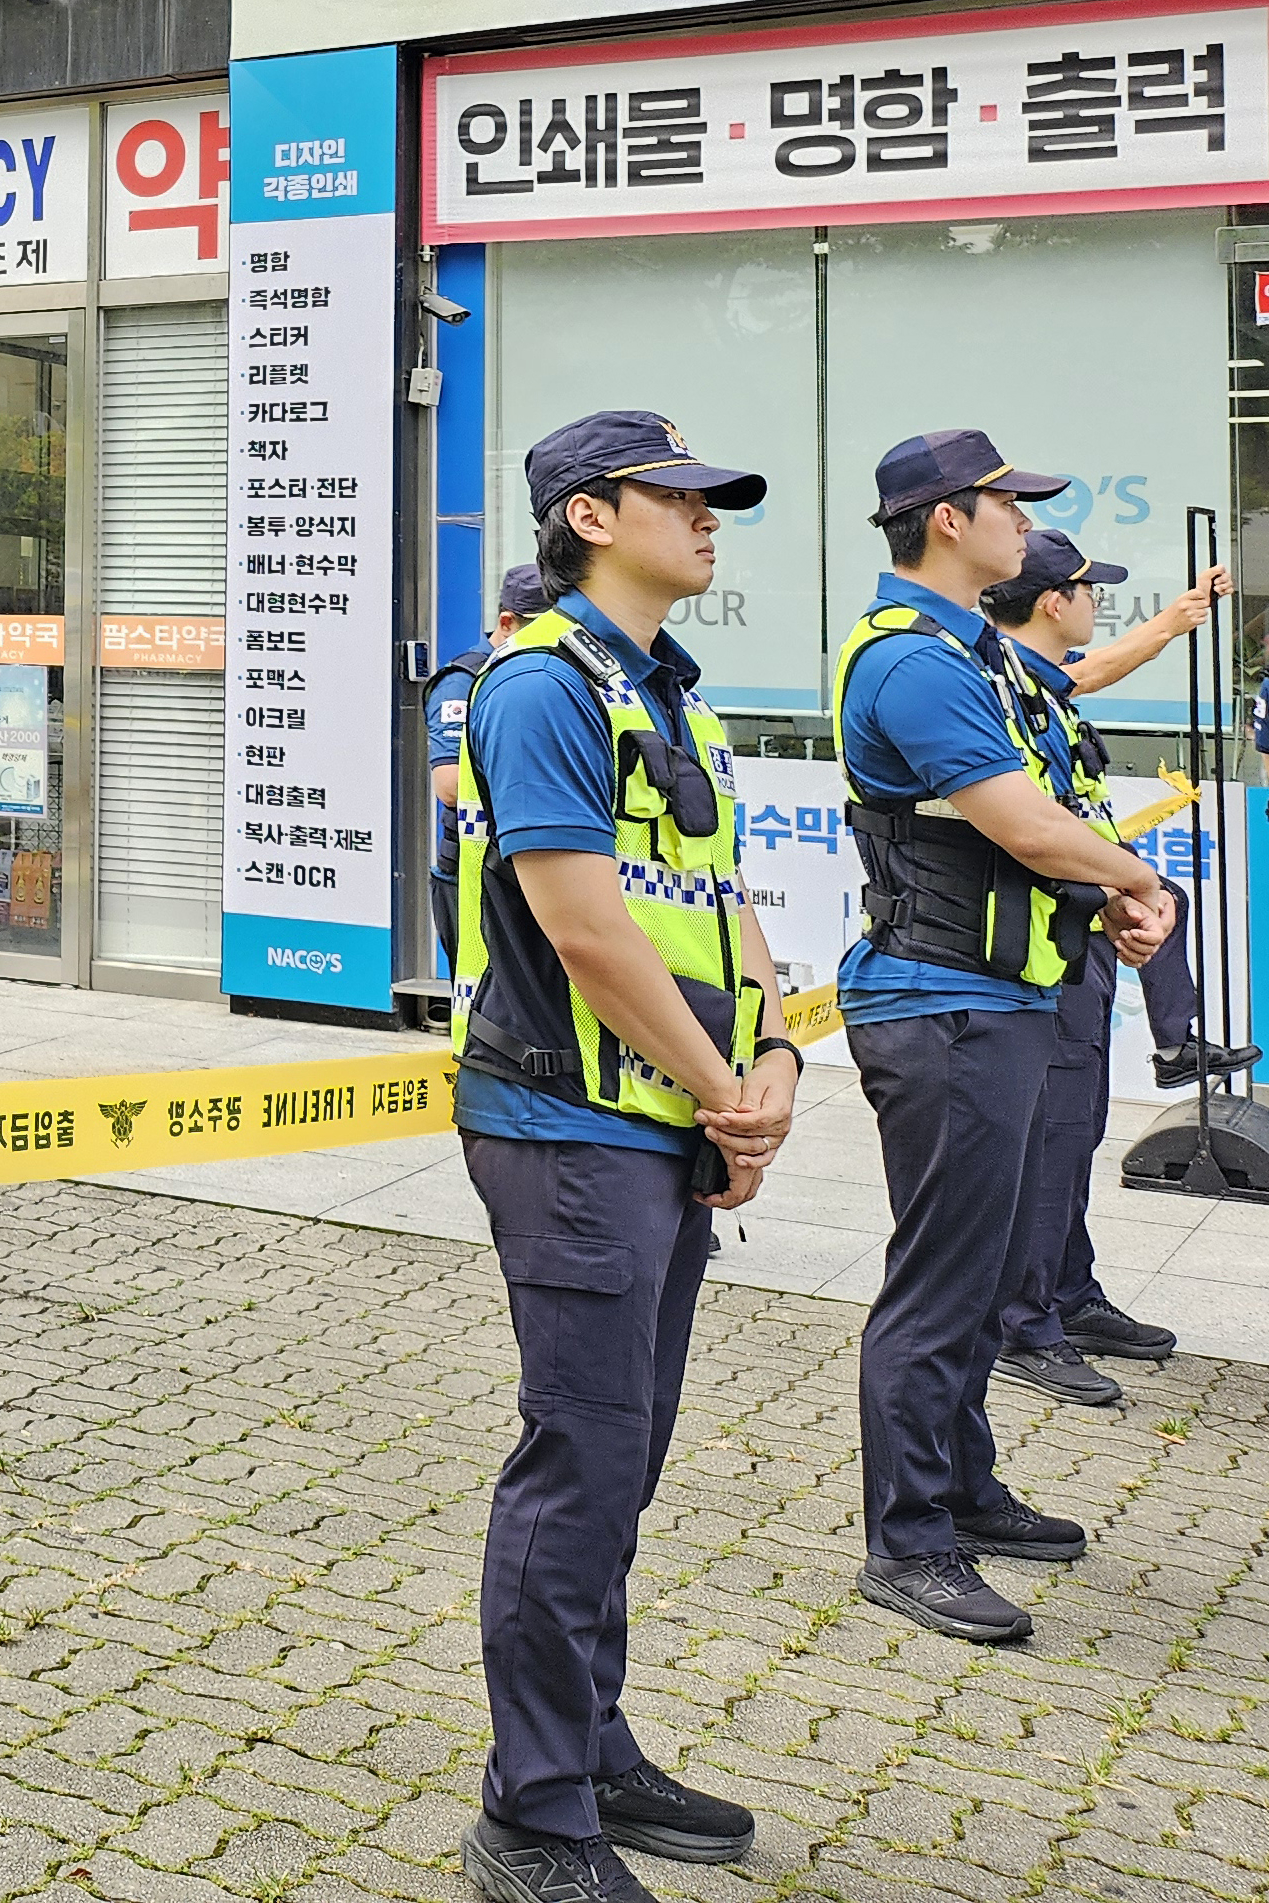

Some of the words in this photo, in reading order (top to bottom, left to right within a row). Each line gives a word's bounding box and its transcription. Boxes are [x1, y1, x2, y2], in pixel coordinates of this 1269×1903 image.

[457, 86, 708, 197] 인쇄물
[770, 66, 959, 178] 명함
[1021, 42, 1226, 164] 출력
[275, 138, 345, 167] 디자인
[115, 110, 230, 260] 약
[263, 170, 357, 201] 각종인쇄
[250, 251, 290, 273] 명함
[249, 287, 331, 310] 즉석명함
[249, 326, 309, 348] 스티커
[249, 364, 309, 385] 리플렛
[248, 402, 329, 423] 카다로그
[248, 440, 288, 461] 책자
[247, 593, 349, 615] 대형현수막
[246, 630, 307, 653] 폼보드
[134, 653, 202, 663] PHARMACY
[246, 669, 306, 691] 포맥스
[246, 707, 306, 730] 아크릴
[245, 745, 286, 768] 현판
[245, 784, 326, 809] 대형출력
[735, 803, 842, 854] 수막
